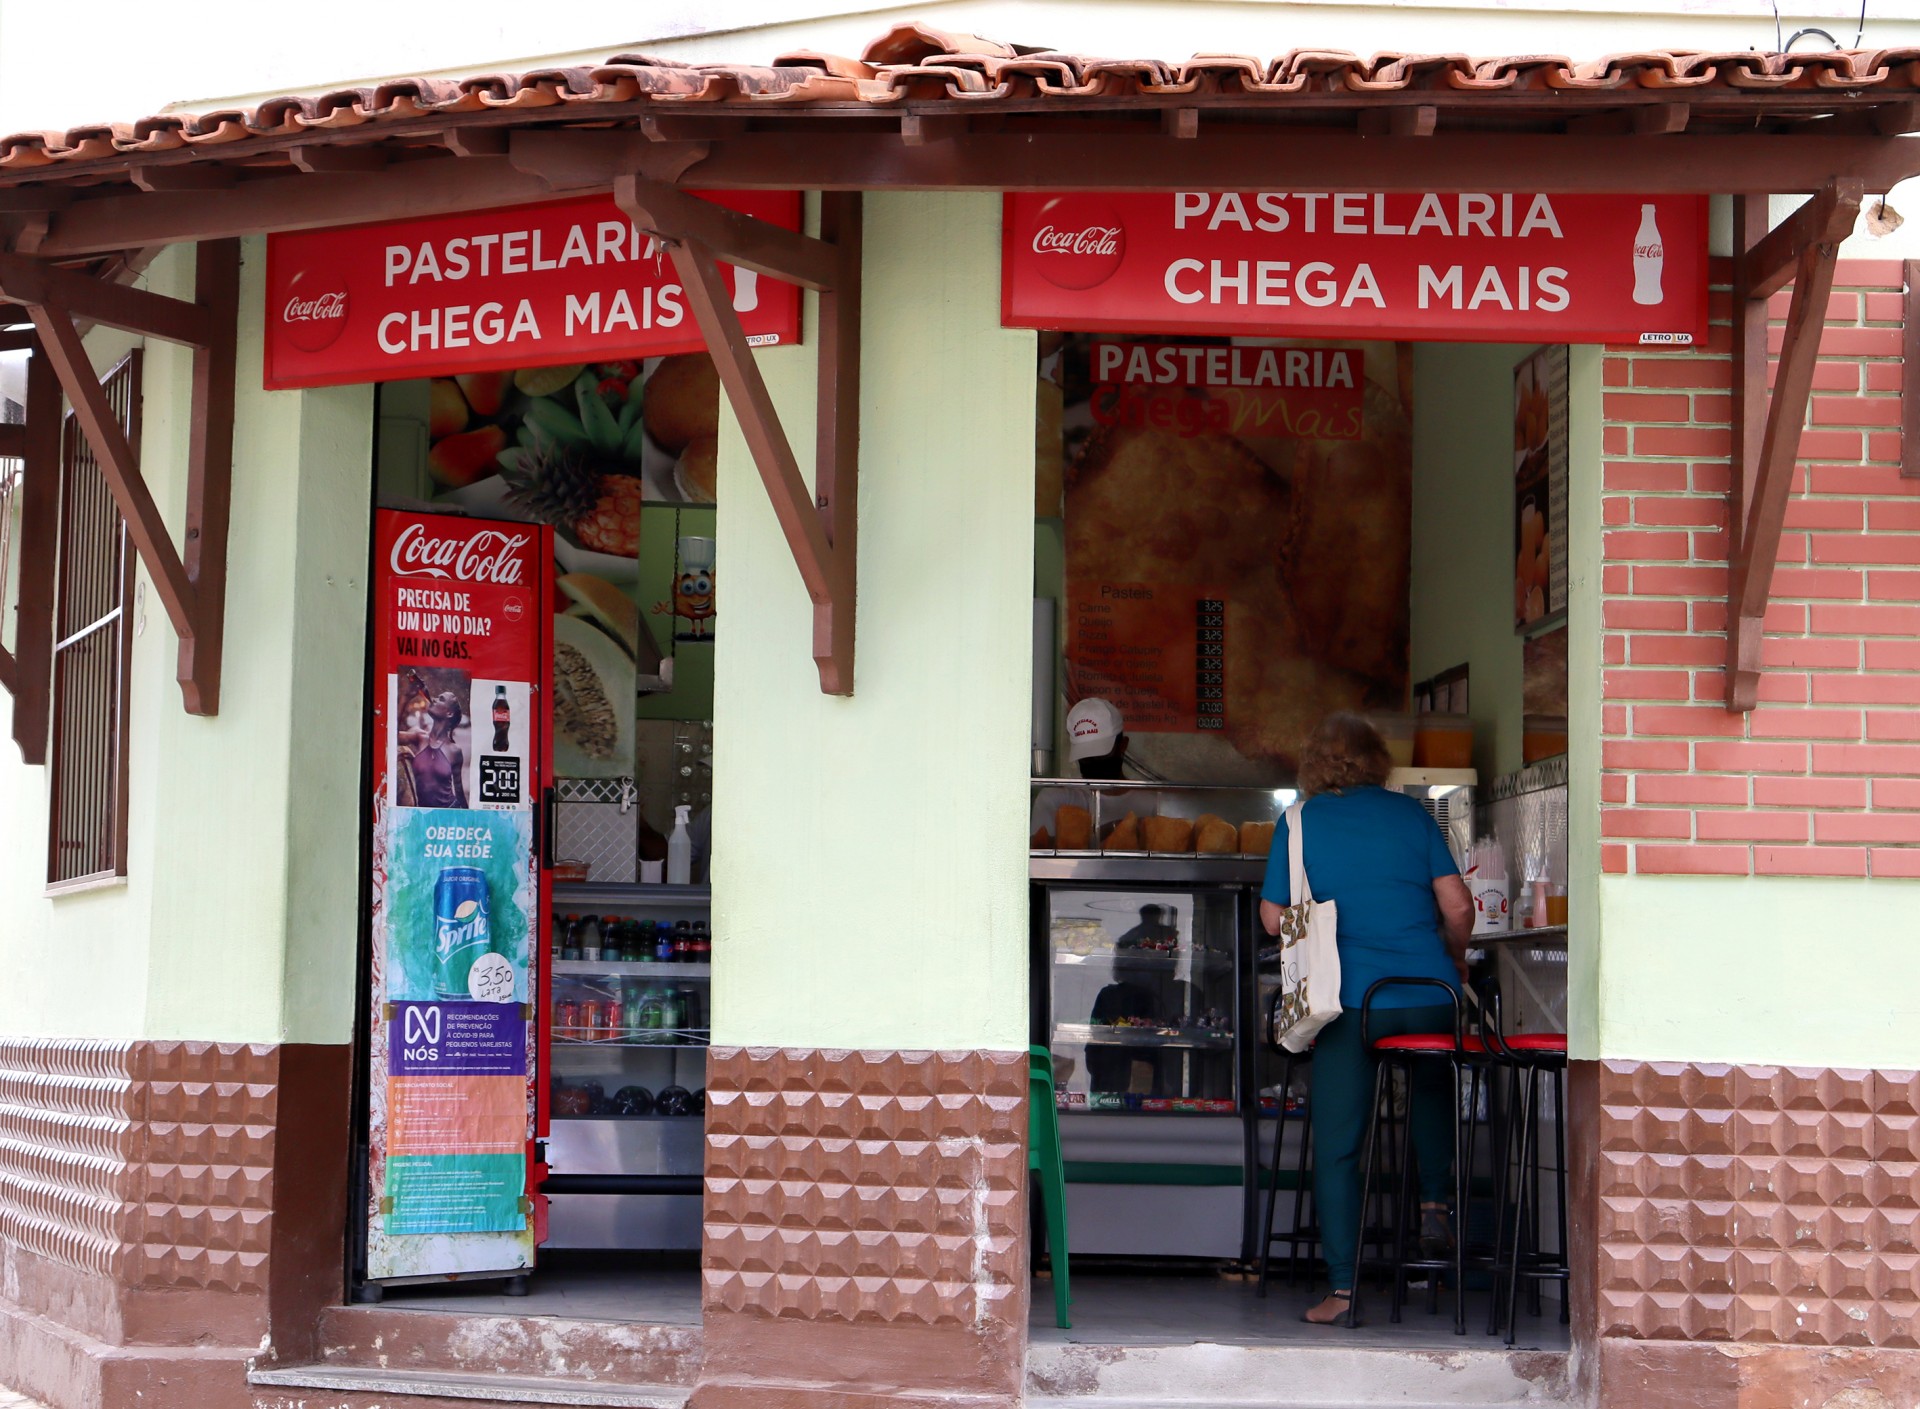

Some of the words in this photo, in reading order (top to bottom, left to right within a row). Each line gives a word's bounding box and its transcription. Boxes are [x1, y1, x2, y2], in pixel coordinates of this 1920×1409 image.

[1173, 191, 1565, 239] PASTELARIA
[1032, 224, 1118, 256] Coca-Cola
[1163, 257, 1387, 309] CHEGA
[1417, 263, 1571, 313] MAIS
[283, 291, 347, 323] Coca-Cola
[377, 299, 541, 354] CHEGA
[564, 283, 684, 337] MAIS
[1098, 344, 1354, 389] PASTELARIA
[1090, 384, 1231, 439] Chega
[1215, 388, 1362, 438] Mais
[390, 523, 531, 584] Coca-Cola
[397, 587, 451, 611] PRECISA
[454, 593, 471, 612] DE
[1078, 602, 1111, 613] Carne
[1204, 601, 1223, 612] 3,25
[397, 611, 420, 632] UM
[422, 613, 440, 633] UP
[443, 615, 461, 634] NO
[463, 616, 491, 636] DIA?
[1078, 616, 1113, 629] Queijo
[1204, 615, 1223, 626] 3,25
[1204, 630, 1223, 641] 3,25
[397, 636, 418, 657] VAI
[421, 638, 440, 658] NO
[443, 635, 472, 660] GÁS.
[1078, 644, 1116, 656] Frango
[1119, 644, 1163, 656] Catupiry
[1204, 644, 1223, 655] 3,25
[1204, 658, 1223, 669] 3,25
[1204, 673, 1223, 684] 3,25
[1078, 684, 1111, 694] Bacon
[1204, 687, 1223, 698] 3,25
[482, 769, 518, 798] 2,00
[425, 826, 493, 845] OBEDEÇA
[424, 844, 453, 858] SUA
[436, 913, 487, 955] Sprite
[446, 1013, 500, 1022] RECOMENDAÇÕES
[456, 1022, 493, 1031] PREVENÇÃO
[403, 1045, 439, 1061] NÓS
[445, 1041, 478, 1049] PEQUENOS
